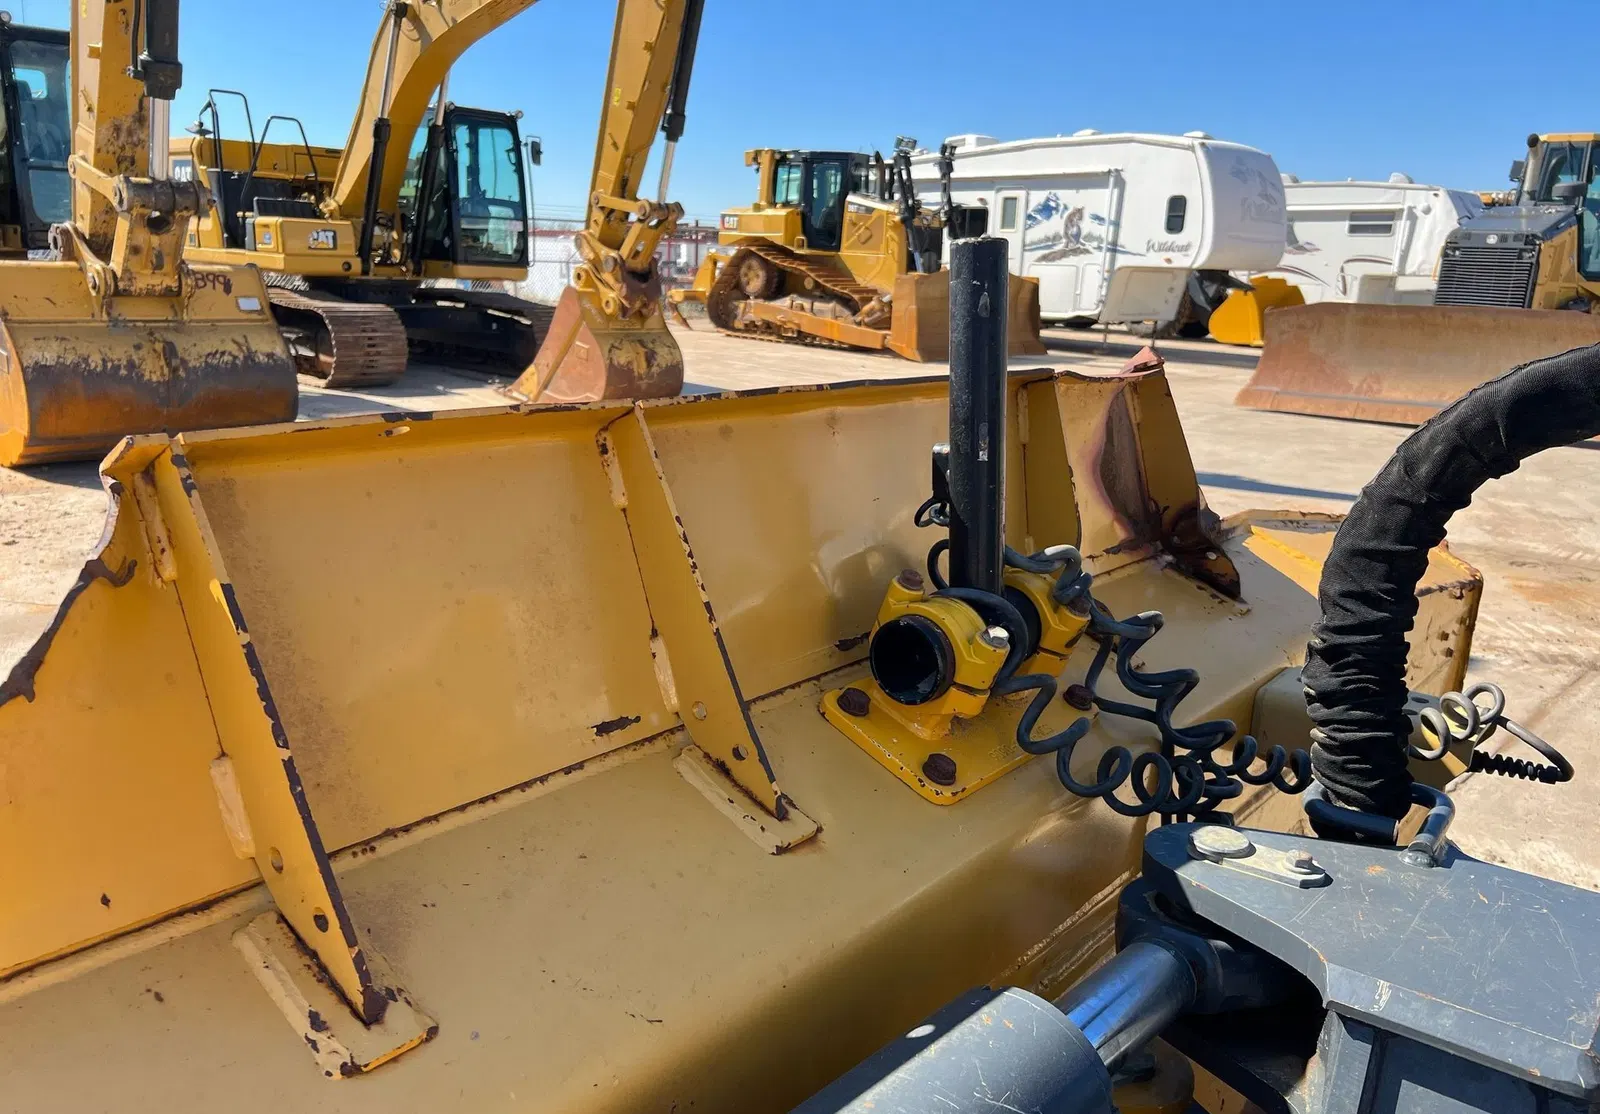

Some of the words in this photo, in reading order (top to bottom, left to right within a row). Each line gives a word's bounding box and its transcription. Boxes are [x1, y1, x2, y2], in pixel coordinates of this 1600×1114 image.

[174, 165, 193, 182] CAT
[724, 216, 739, 229] CAT
[308, 229, 334, 249] CAT
[1146, 239, 1192, 252] Wildcat
